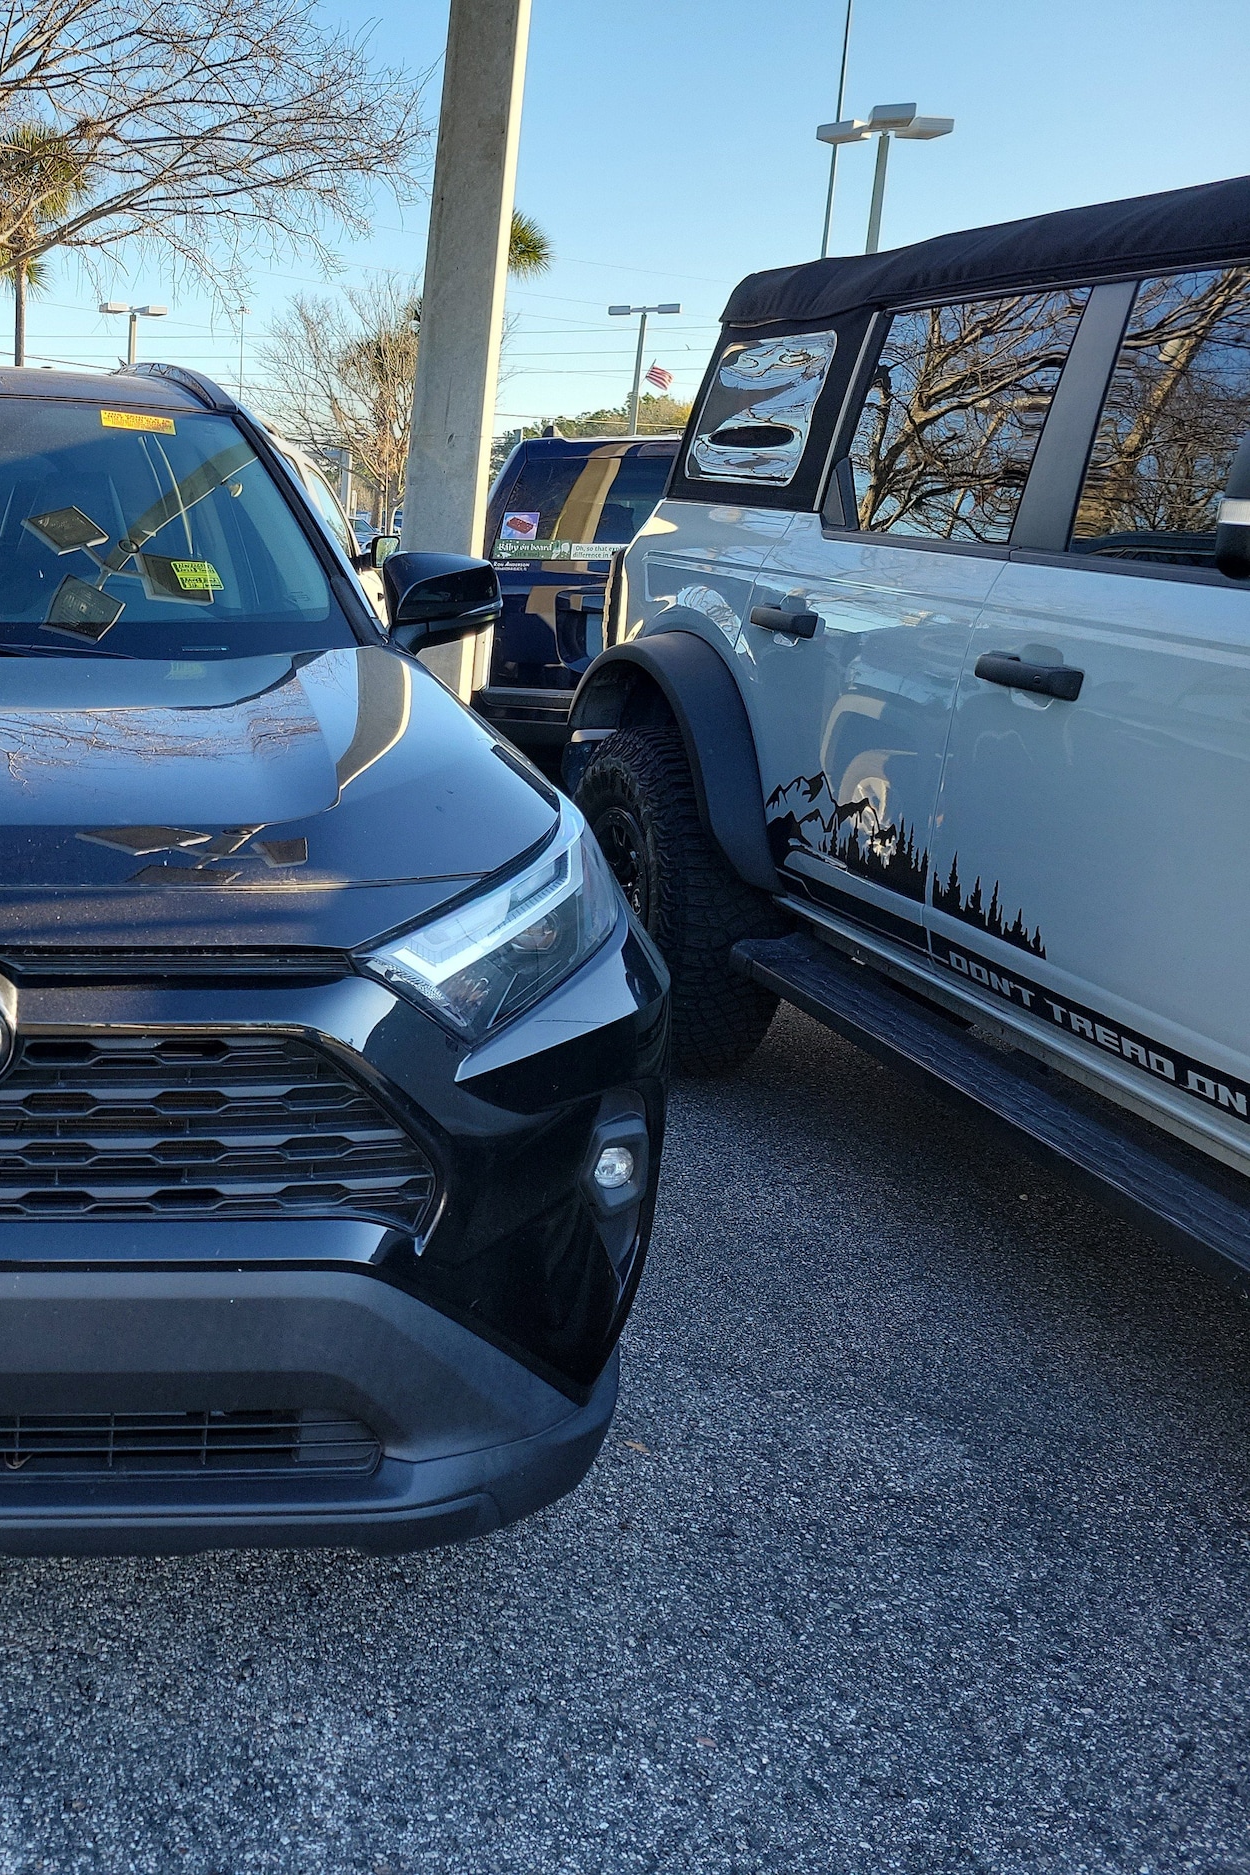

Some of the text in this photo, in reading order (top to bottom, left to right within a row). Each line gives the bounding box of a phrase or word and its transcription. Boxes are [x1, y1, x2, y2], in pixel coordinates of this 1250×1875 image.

[499, 543, 519, 553] Baby
[531, 543, 552, 551] board
[948, 950, 1248, 1115] DON'T TREAD ON
